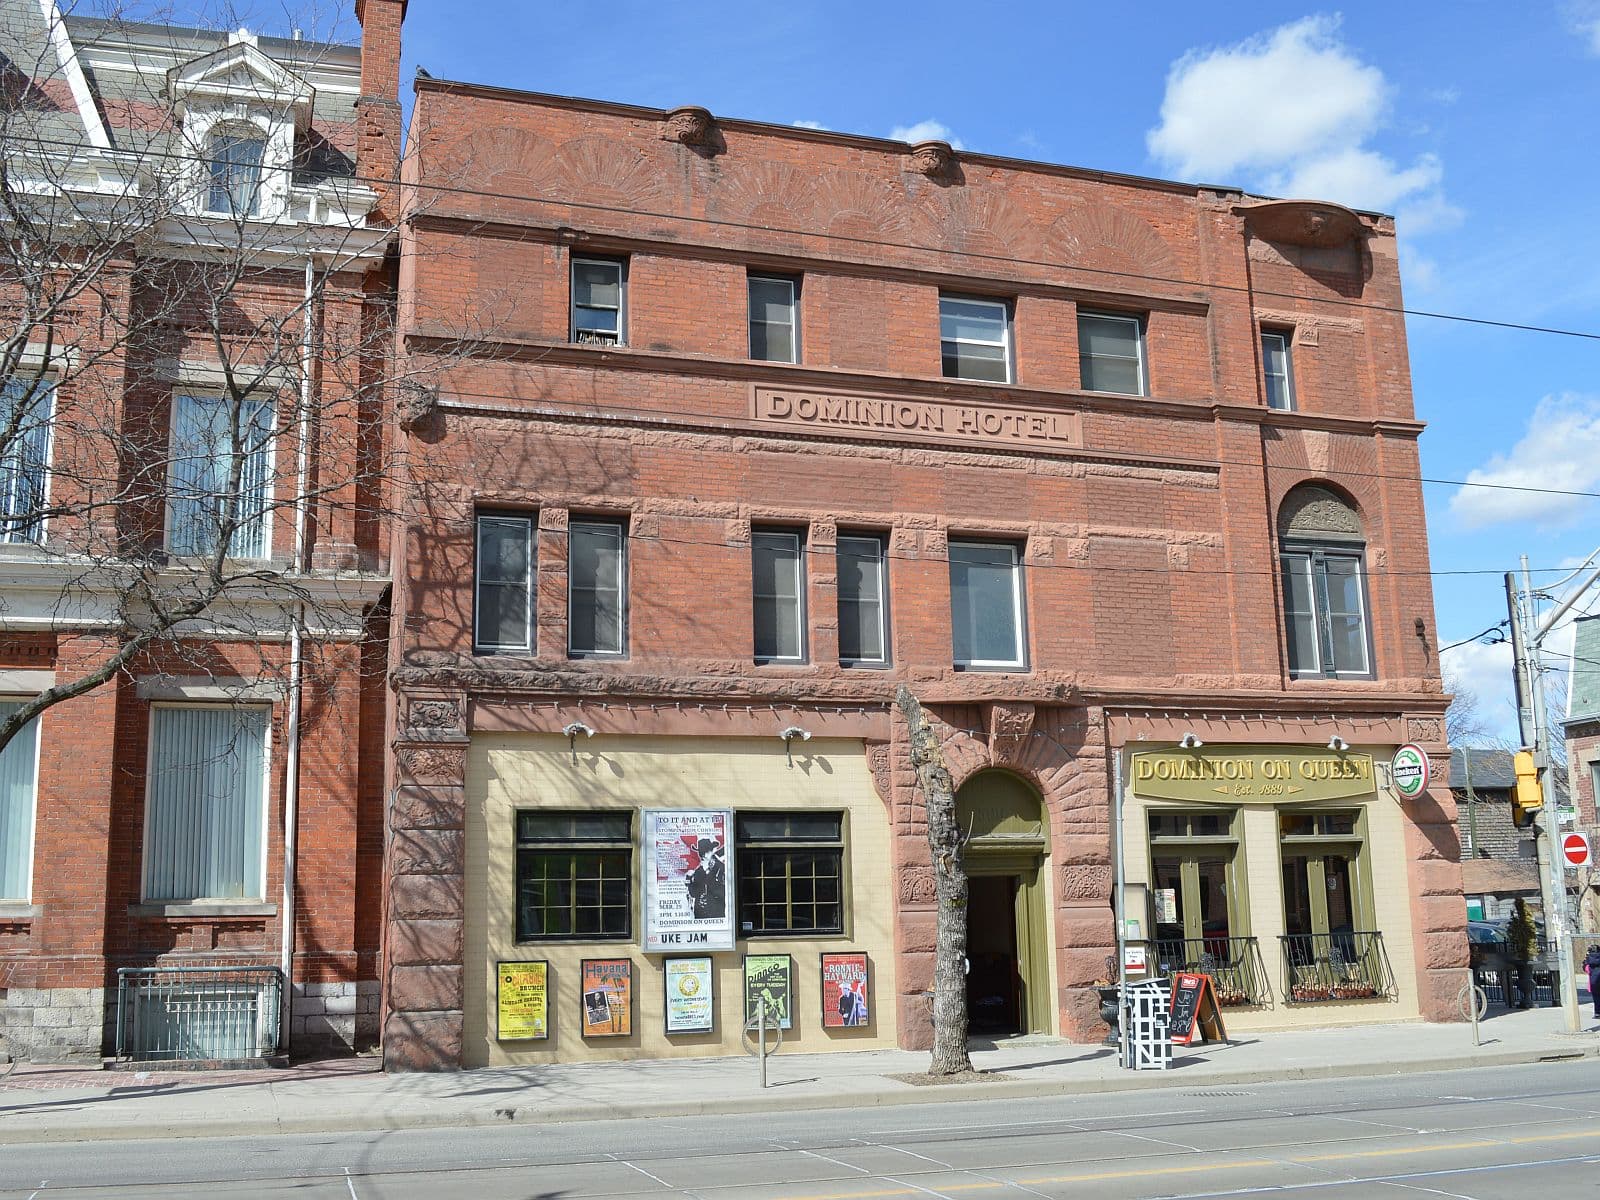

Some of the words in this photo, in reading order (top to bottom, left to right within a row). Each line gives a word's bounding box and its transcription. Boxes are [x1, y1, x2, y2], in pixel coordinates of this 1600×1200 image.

[767, 393, 945, 432] DOMINION
[956, 406, 1069, 442] HOTEL
[1137, 759, 1253, 780] DOMINION
[1261, 760, 1291, 780] ON
[1299, 760, 1369, 781] QUEEN
[1233, 783, 1254, 796] Est.
[1259, 783, 1283, 796] 1889
[661, 933, 681, 943] UKE
[687, 933, 708, 943] JAM
[586, 963, 627, 978] Havana
[829, 963, 860, 973] RONNIE
[824, 972, 865, 981] HAYWARD
